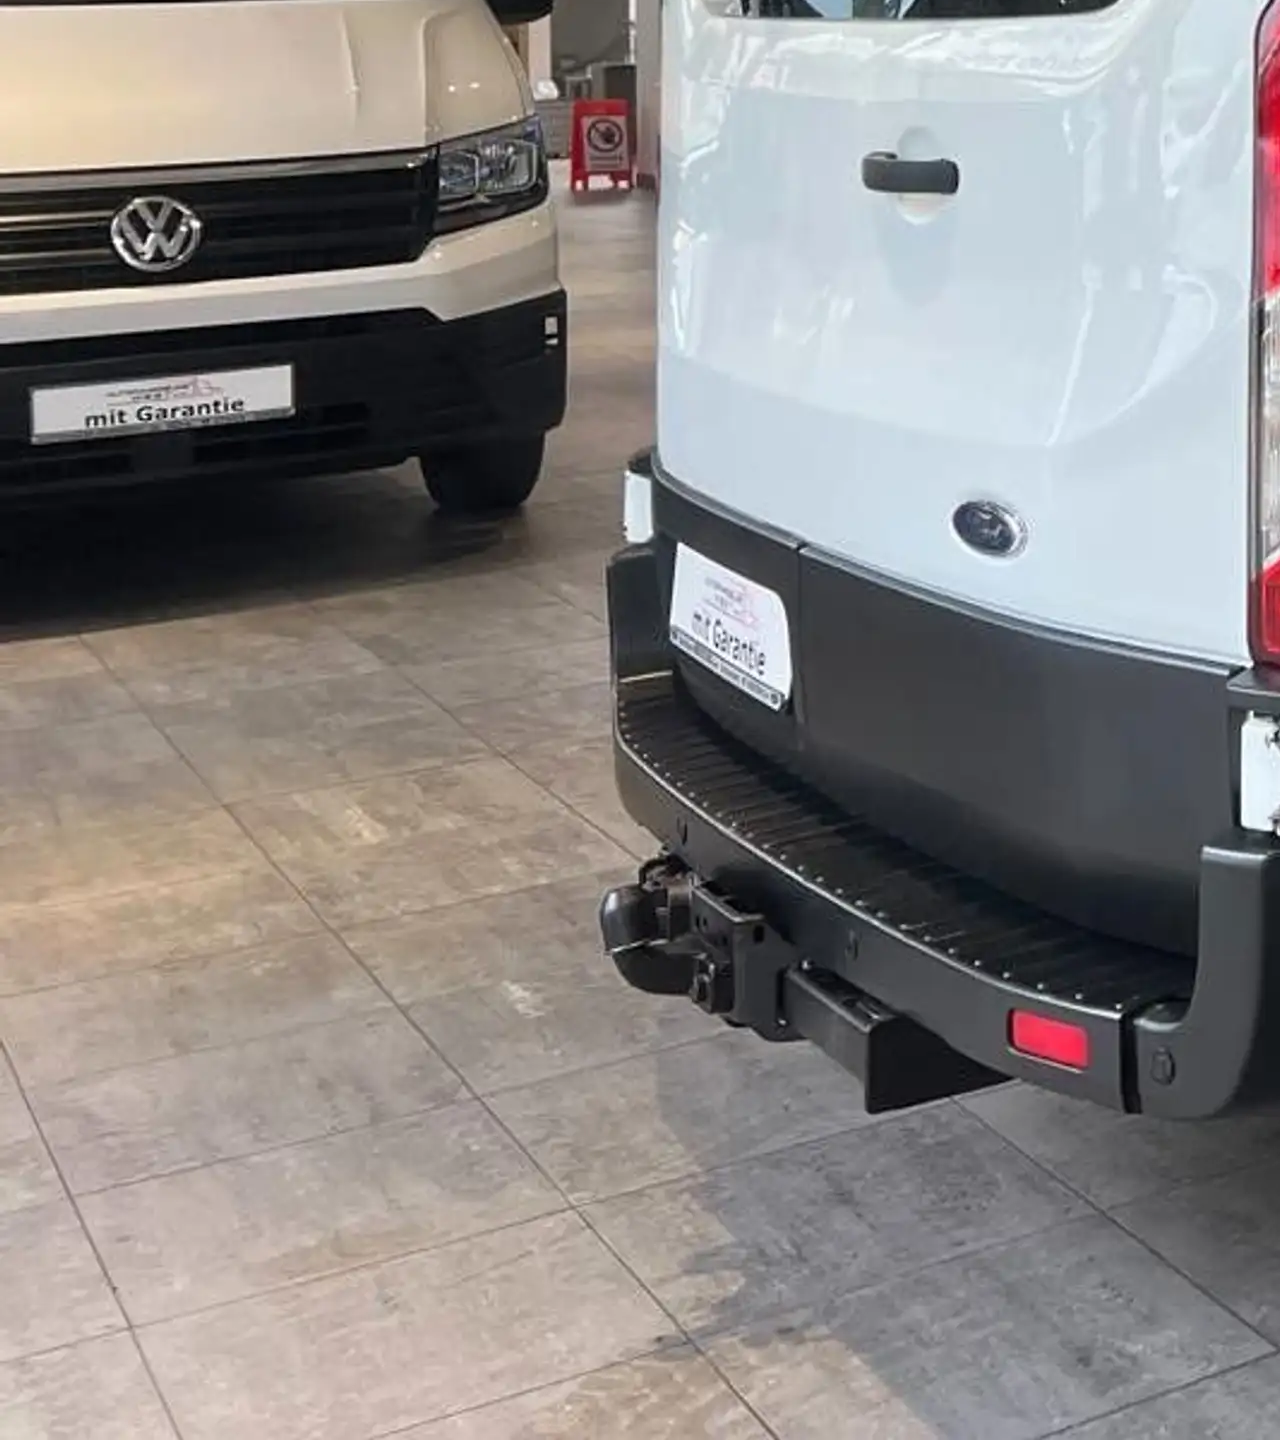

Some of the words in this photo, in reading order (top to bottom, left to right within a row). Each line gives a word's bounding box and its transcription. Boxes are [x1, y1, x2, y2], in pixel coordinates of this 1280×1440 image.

[84, 410, 127, 429] mit
[136, 396, 244, 422] Garantie
[713, 618, 766, 677] Garantie
